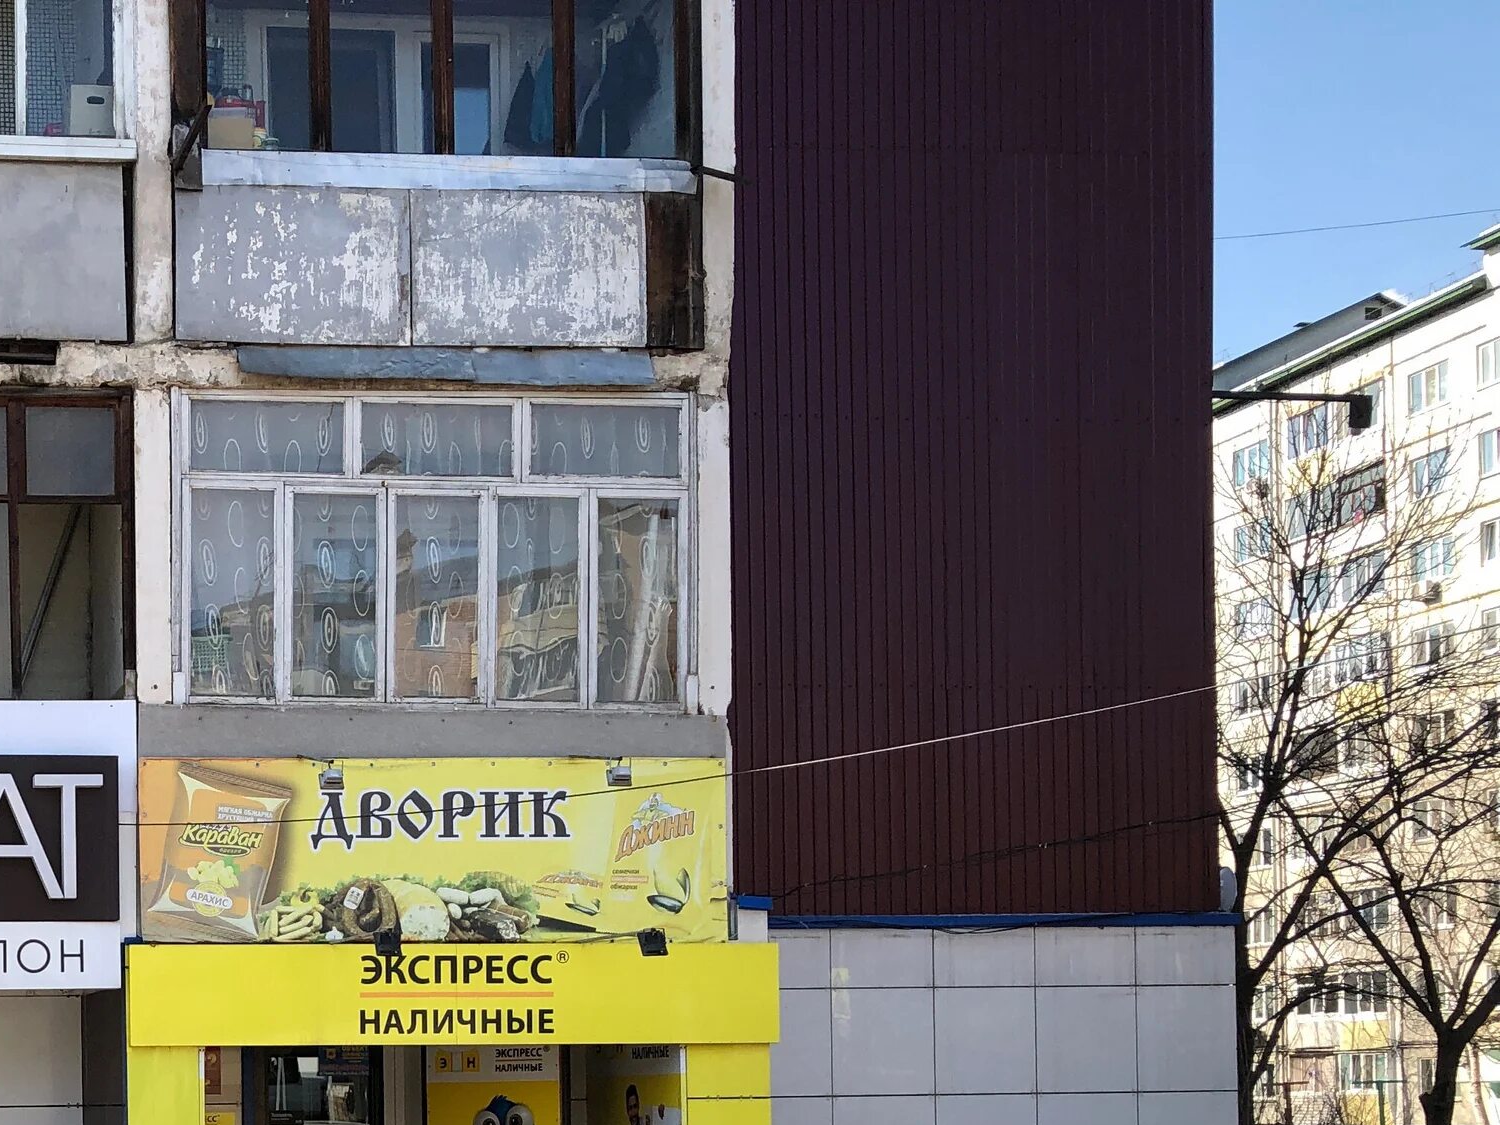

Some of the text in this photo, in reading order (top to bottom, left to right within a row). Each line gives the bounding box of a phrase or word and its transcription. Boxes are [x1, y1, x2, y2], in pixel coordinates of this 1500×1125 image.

[310, 788, 571, 850] ДВОРИК
[190, 890, 229, 909] АРАХИС
[359, 1009, 555, 1035] НАЛИЧНЫЕ
[494, 1063, 543, 1073] НАЛИЧНЫЕ
